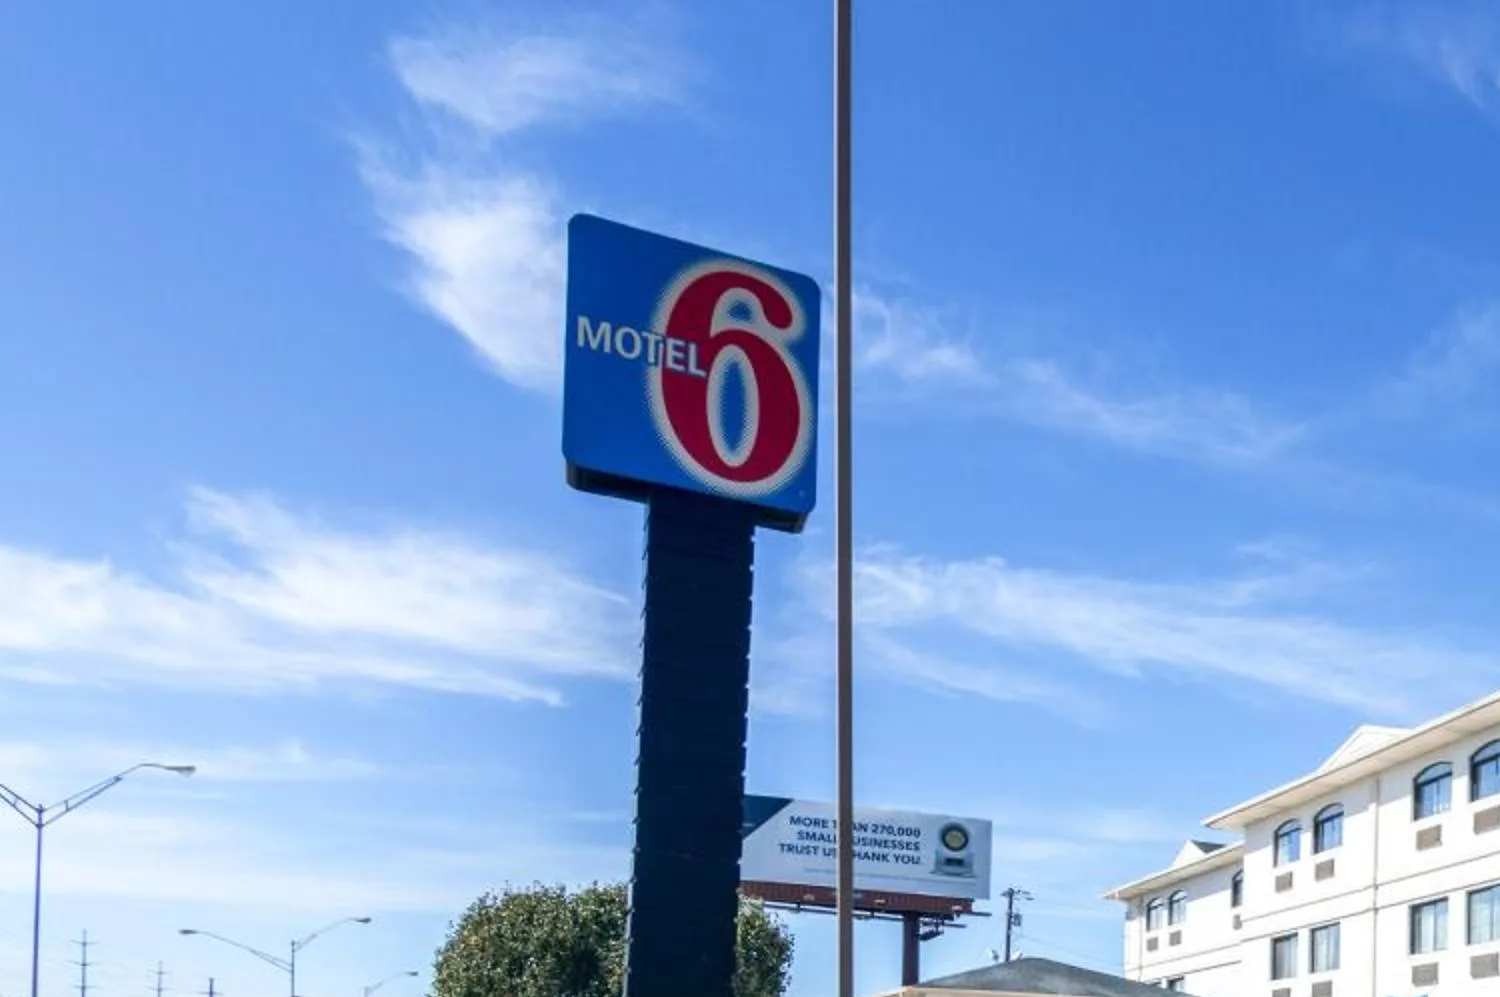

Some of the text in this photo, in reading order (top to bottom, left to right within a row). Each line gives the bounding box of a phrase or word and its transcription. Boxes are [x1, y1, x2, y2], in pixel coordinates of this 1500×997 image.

[576, 268, 803, 484] MOTEL 6
[789, 815, 921, 838] MORE TAN 270,000
[779, 843, 819, 856] TRUST
[852, 850, 891, 863] HANK
[852, 835, 921, 852] USINESSES
